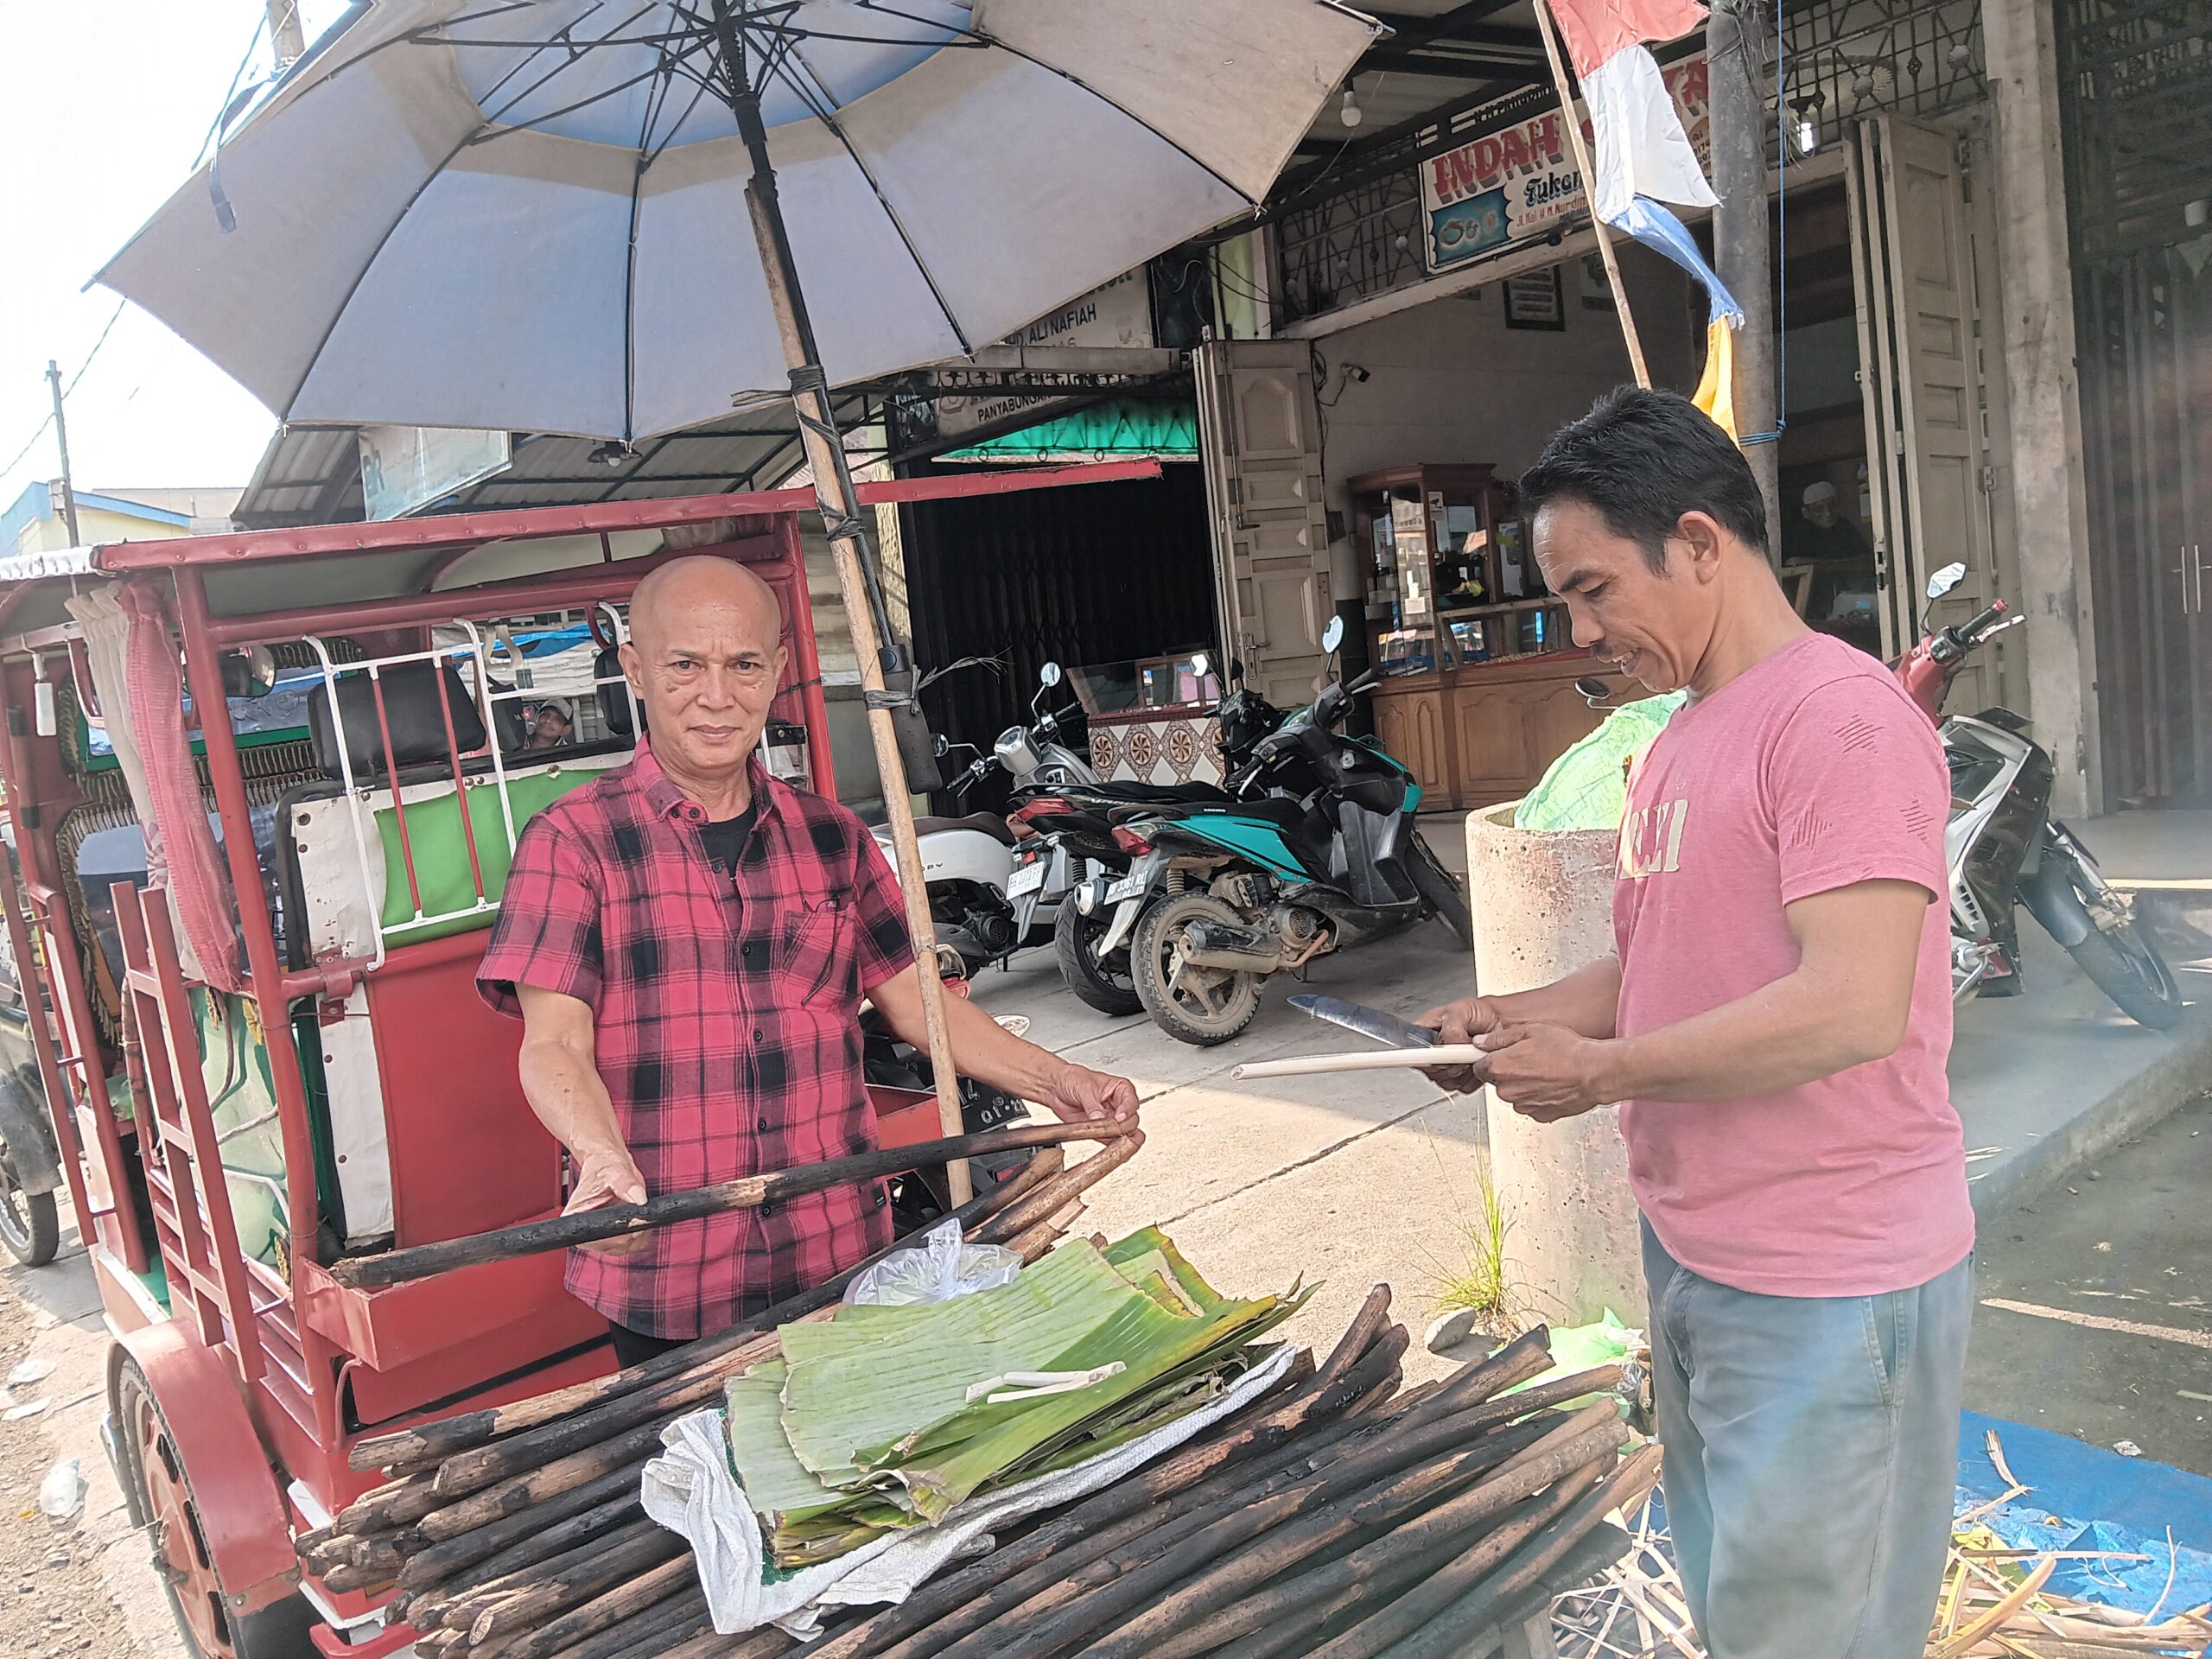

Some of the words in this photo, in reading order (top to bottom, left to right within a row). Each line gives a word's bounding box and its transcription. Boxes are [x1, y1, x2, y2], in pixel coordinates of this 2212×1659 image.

[1432, 113, 1563, 202] INDAH
[1029, 323, 1048, 344] ALI
[1050, 302, 1097, 336] NAFIAH
